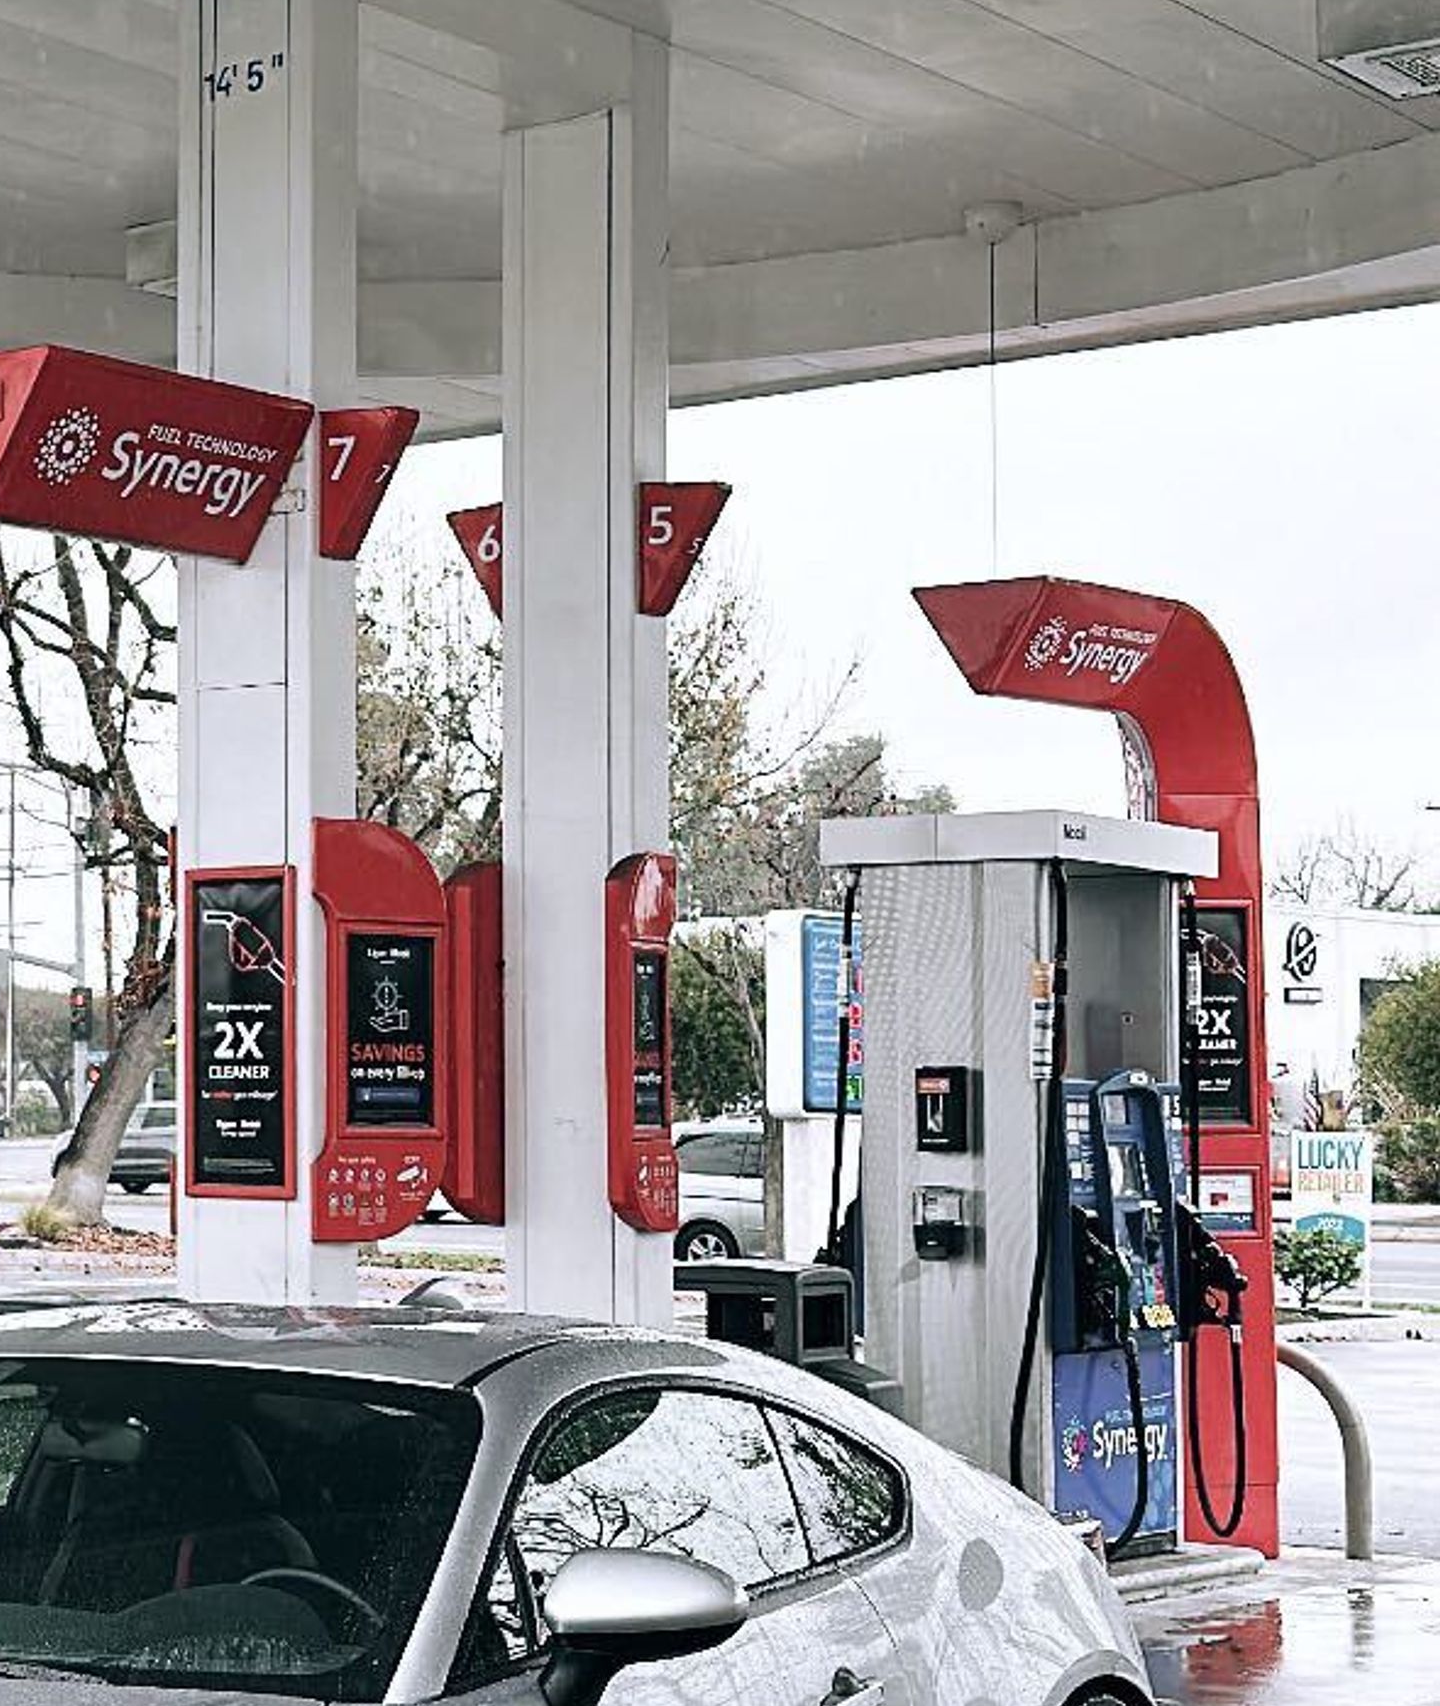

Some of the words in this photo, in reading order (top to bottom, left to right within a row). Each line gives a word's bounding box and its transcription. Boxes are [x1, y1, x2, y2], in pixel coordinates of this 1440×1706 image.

[204, 64, 237, 102] 14'
[148, 424, 182, 444] FUEL
[187, 432, 279, 462] TECHNOLOGY
[327, 436, 355, 481] 7
[101, 432, 266, 518] Synergy
[476, 524, 501, 562] 6
[648, 506, 673, 545] 5
[1060, 631, 1148, 684] Synergy
[213, 1021, 264, 1059] 2X
[1197, 1009, 1231, 1035] 2X
[208, 1064, 270, 1080] CLEANER
[350, 1043, 425, 1063] SAVINGS
[1298, 1139, 1364, 1171] LUCKY
[1298, 1172, 1364, 1194] RETAILER
[1093, 1420, 1168, 1469] Synegy
